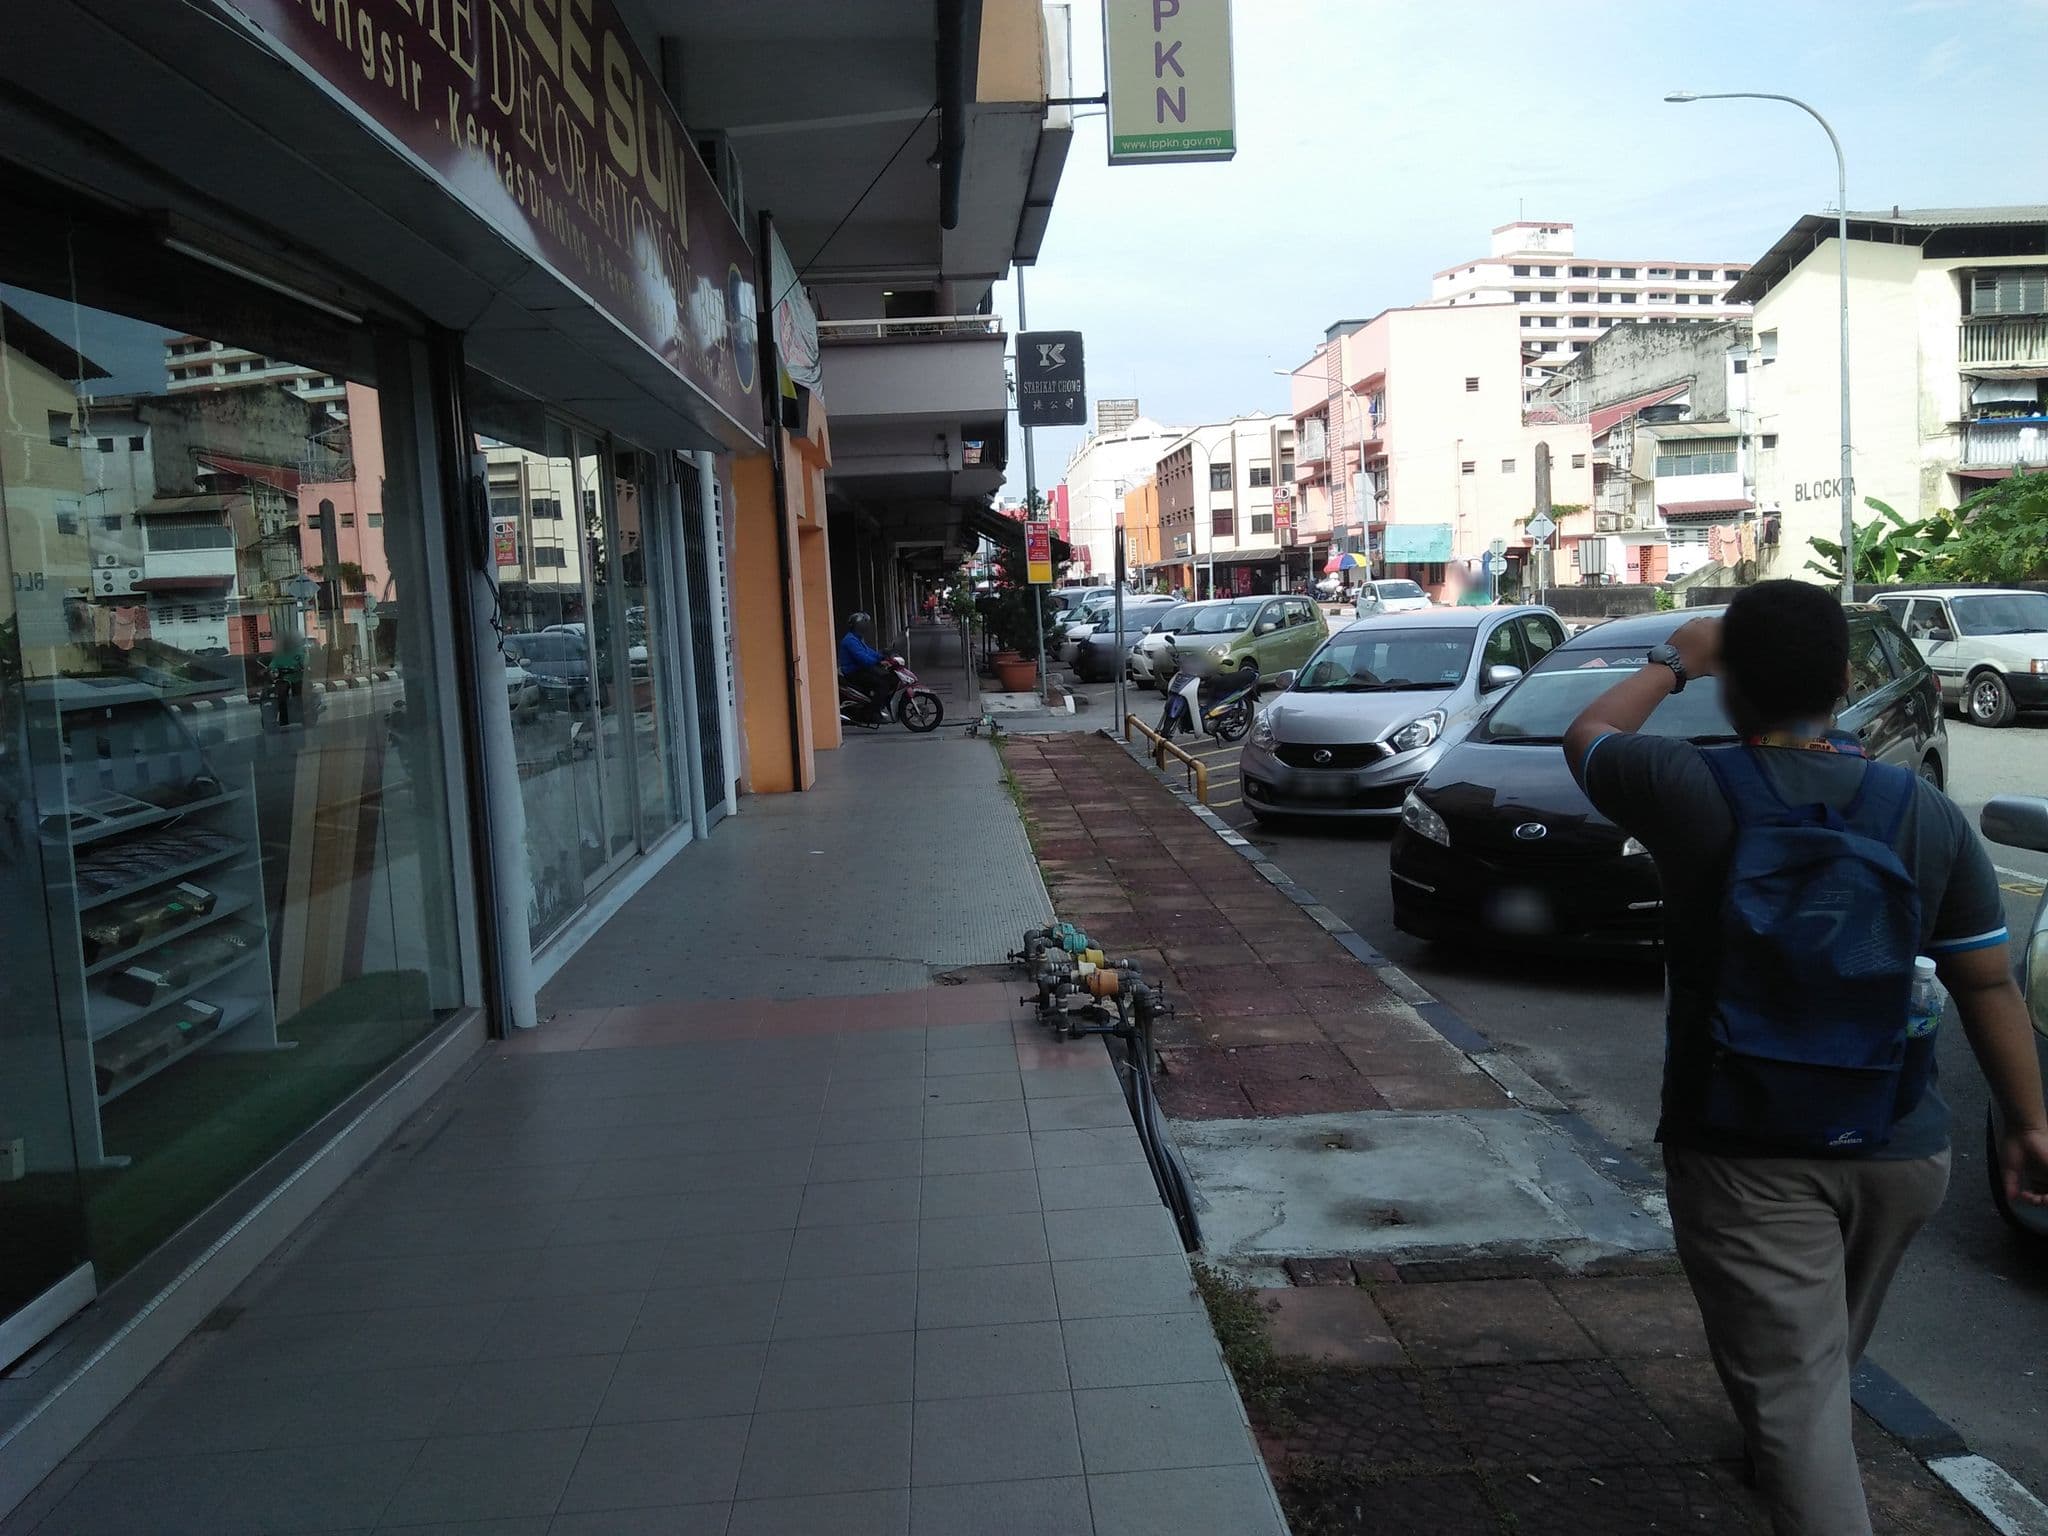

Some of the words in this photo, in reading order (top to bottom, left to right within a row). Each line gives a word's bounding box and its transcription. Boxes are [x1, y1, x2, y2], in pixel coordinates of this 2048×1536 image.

[490, 0, 664, 285] DECORATION
[604, 30, 688, 250] SUN
[1122, 136, 1222, 150] www.lppkn.gov.my
[1023, 381, 1057, 394] SYARIKAT
[1058, 379, 1081, 393] CHONG
[1274, 487, 1289, 499] 4D
[1795, 478, 1842, 502] BLOCK
